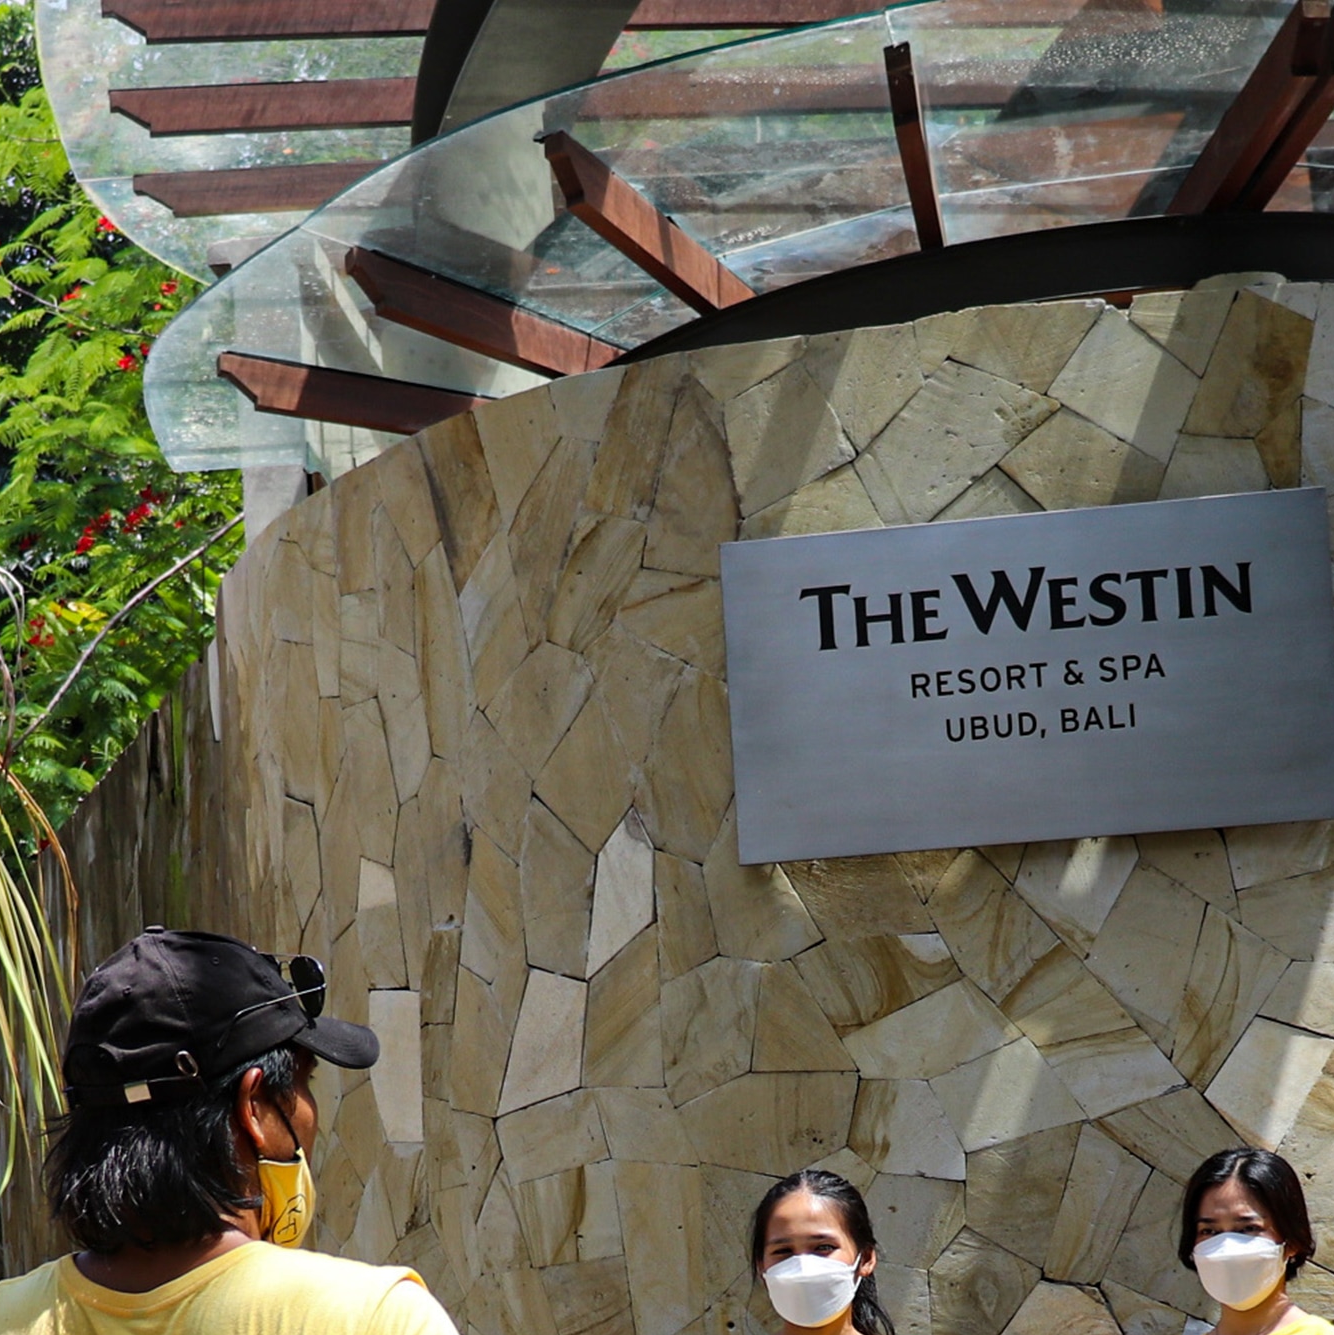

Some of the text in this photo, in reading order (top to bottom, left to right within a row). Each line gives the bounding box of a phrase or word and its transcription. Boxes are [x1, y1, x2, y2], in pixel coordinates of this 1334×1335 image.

[800, 561, 1253, 650] THE WESTIN
[910, 653, 1166, 698] RESORT & SPA
[944, 703, 1137, 743] UBUD, BALI
